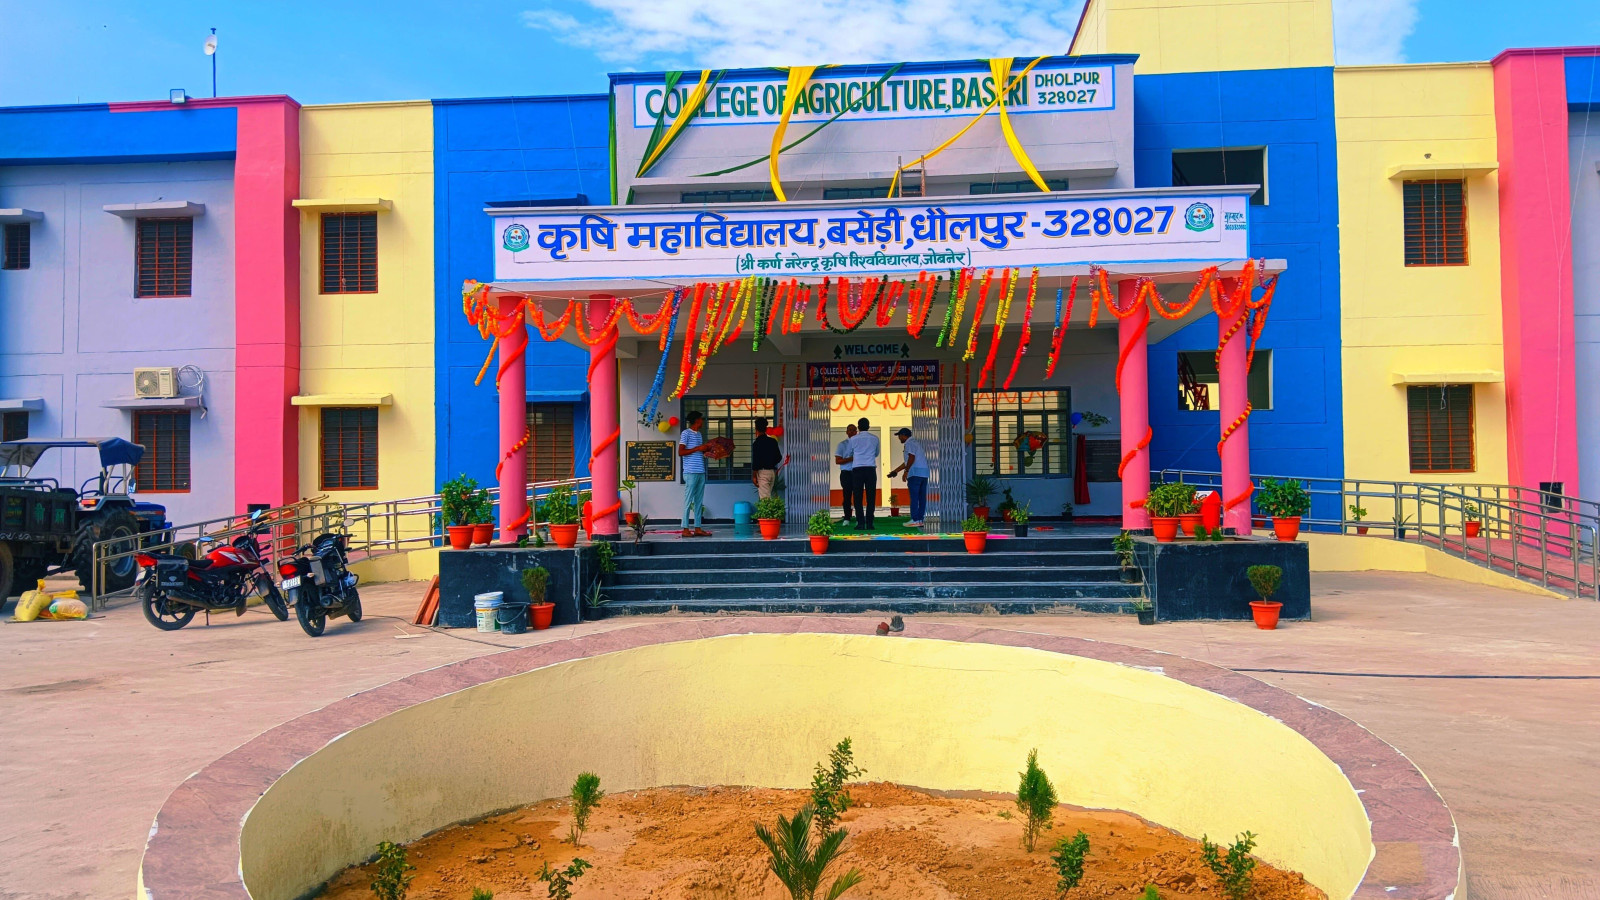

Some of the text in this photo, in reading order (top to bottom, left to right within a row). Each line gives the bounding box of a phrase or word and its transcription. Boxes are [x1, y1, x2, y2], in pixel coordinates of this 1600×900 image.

[1035, 71, 1100, 88] DHOLPUR
[1037, 89, 1097, 105] 328027
[537, 213, 619, 260] कृषि
[757, 252, 783, 269] कर्ण
[820, 251, 848, 270] कृषि
[844, 343, 899, 355] WELCOME
